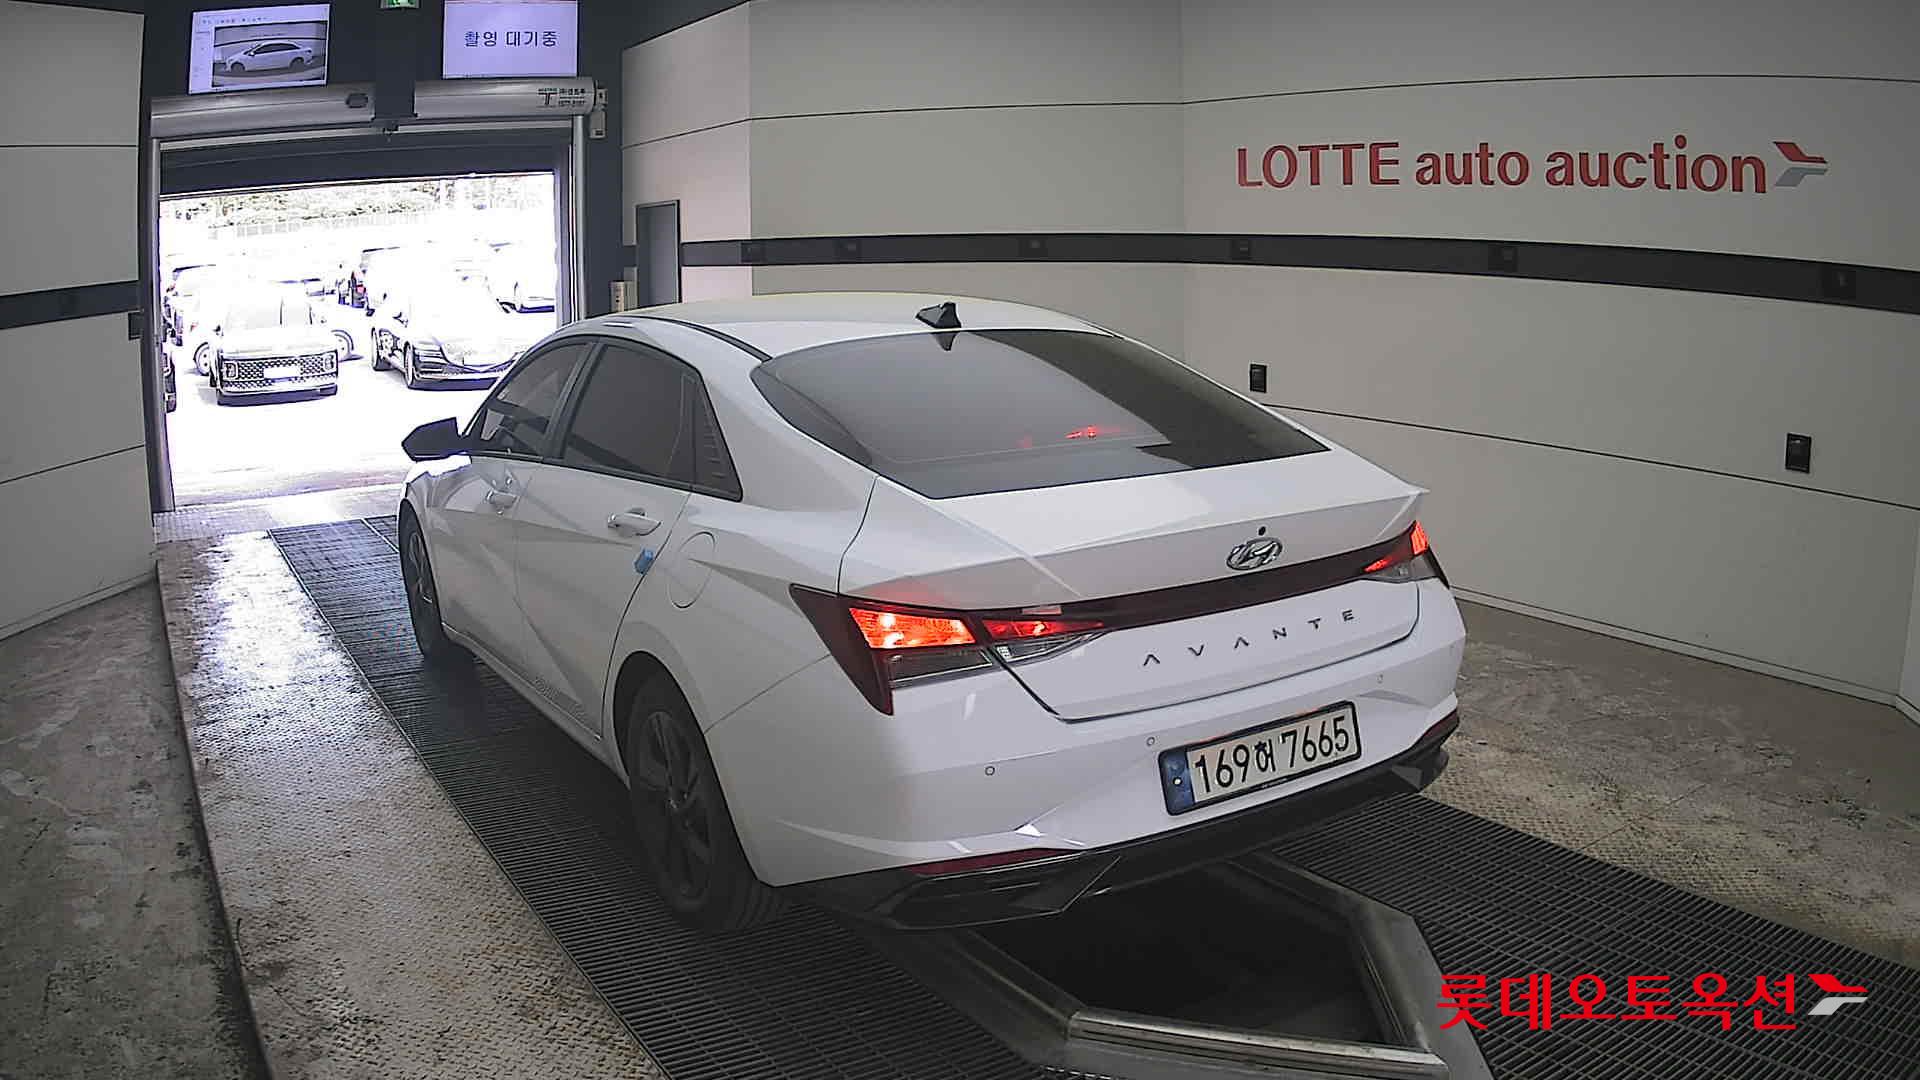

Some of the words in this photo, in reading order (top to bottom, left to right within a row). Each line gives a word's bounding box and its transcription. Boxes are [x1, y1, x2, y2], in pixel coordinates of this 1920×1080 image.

[464, 30, 498, 47] 촬영
[505, 30, 558, 47] 대기중
[1237, 142, 1400, 189] LOTTE
[1415, 142, 1530, 186] auto
[1545, 134, 1767, 194] auction
[1143, 609, 1356, 667] AVANTE
